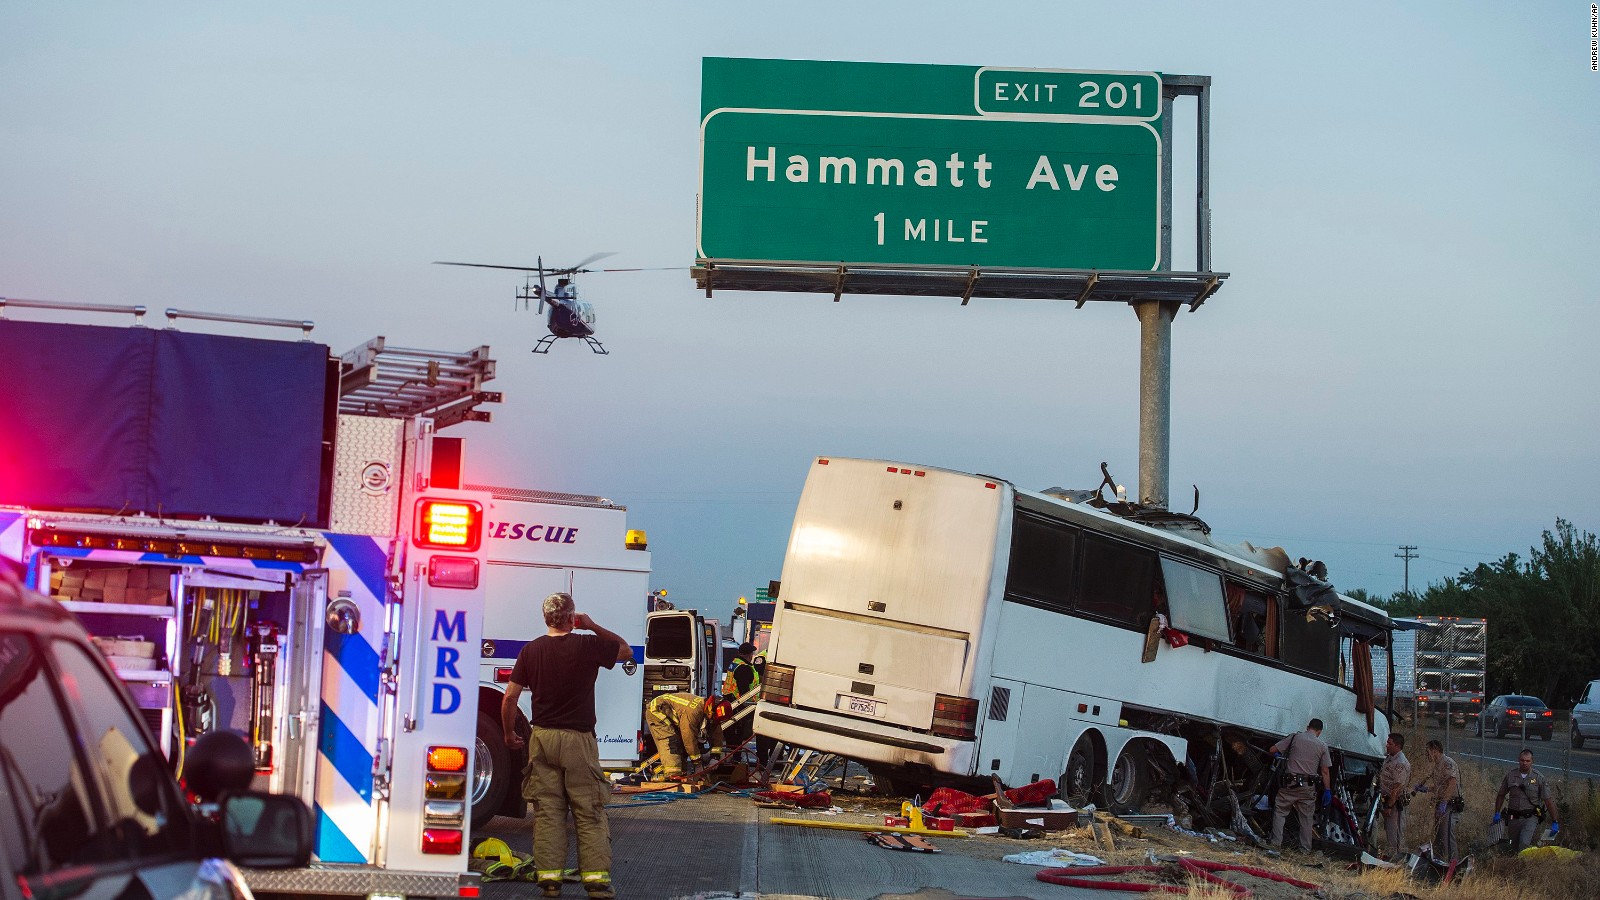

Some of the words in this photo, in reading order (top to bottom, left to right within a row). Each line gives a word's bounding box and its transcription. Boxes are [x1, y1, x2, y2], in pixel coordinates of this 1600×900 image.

[996, 83, 1057, 102] EXIT
[1079, 82, 1141, 108] 201
[747, 147, 991, 188] Hammatt
[1026, 156, 1118, 191] Ave
[874, 213, 884, 245] 1
[905, 219, 987, 242] MILE
[431, 609, 467, 714] MRD
